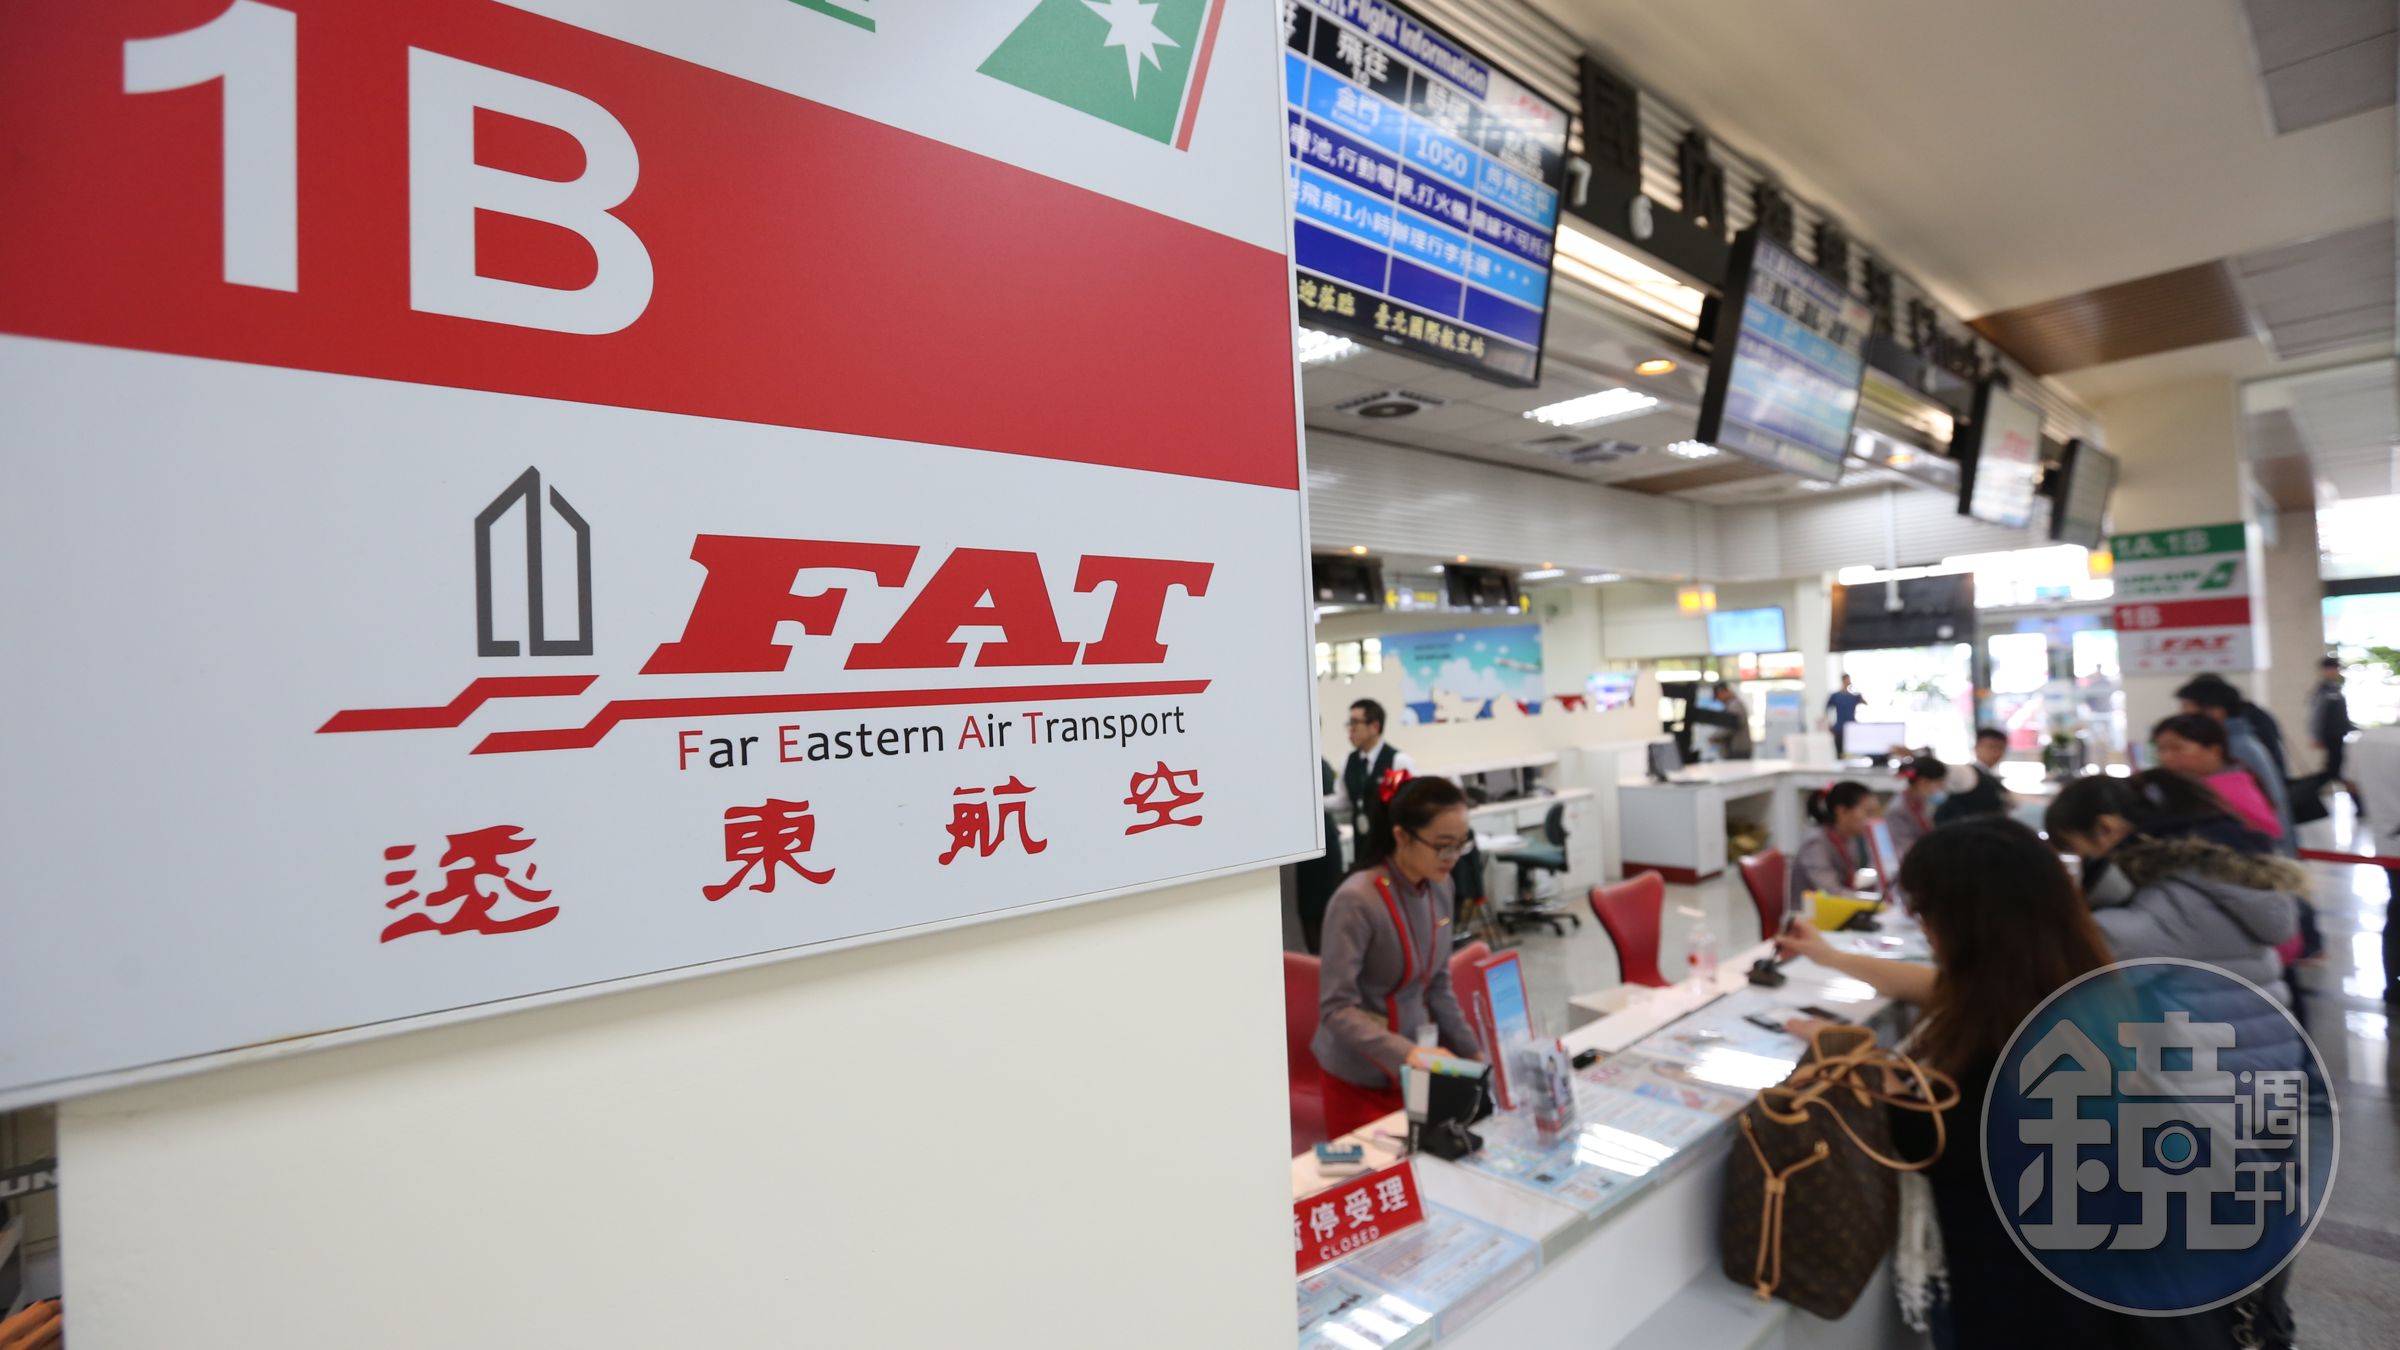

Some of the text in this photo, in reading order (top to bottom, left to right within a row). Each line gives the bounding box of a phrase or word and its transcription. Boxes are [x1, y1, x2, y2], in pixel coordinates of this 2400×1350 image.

[123, 0, 654, 336] 1B
[1416, 133, 1469, 179] 1050
[638, 533, 1215, 675] FAT
[678, 704, 1187, 771] Far Eastern Air Transport
[1319, 1225, 1380, 1260] CLOSED
